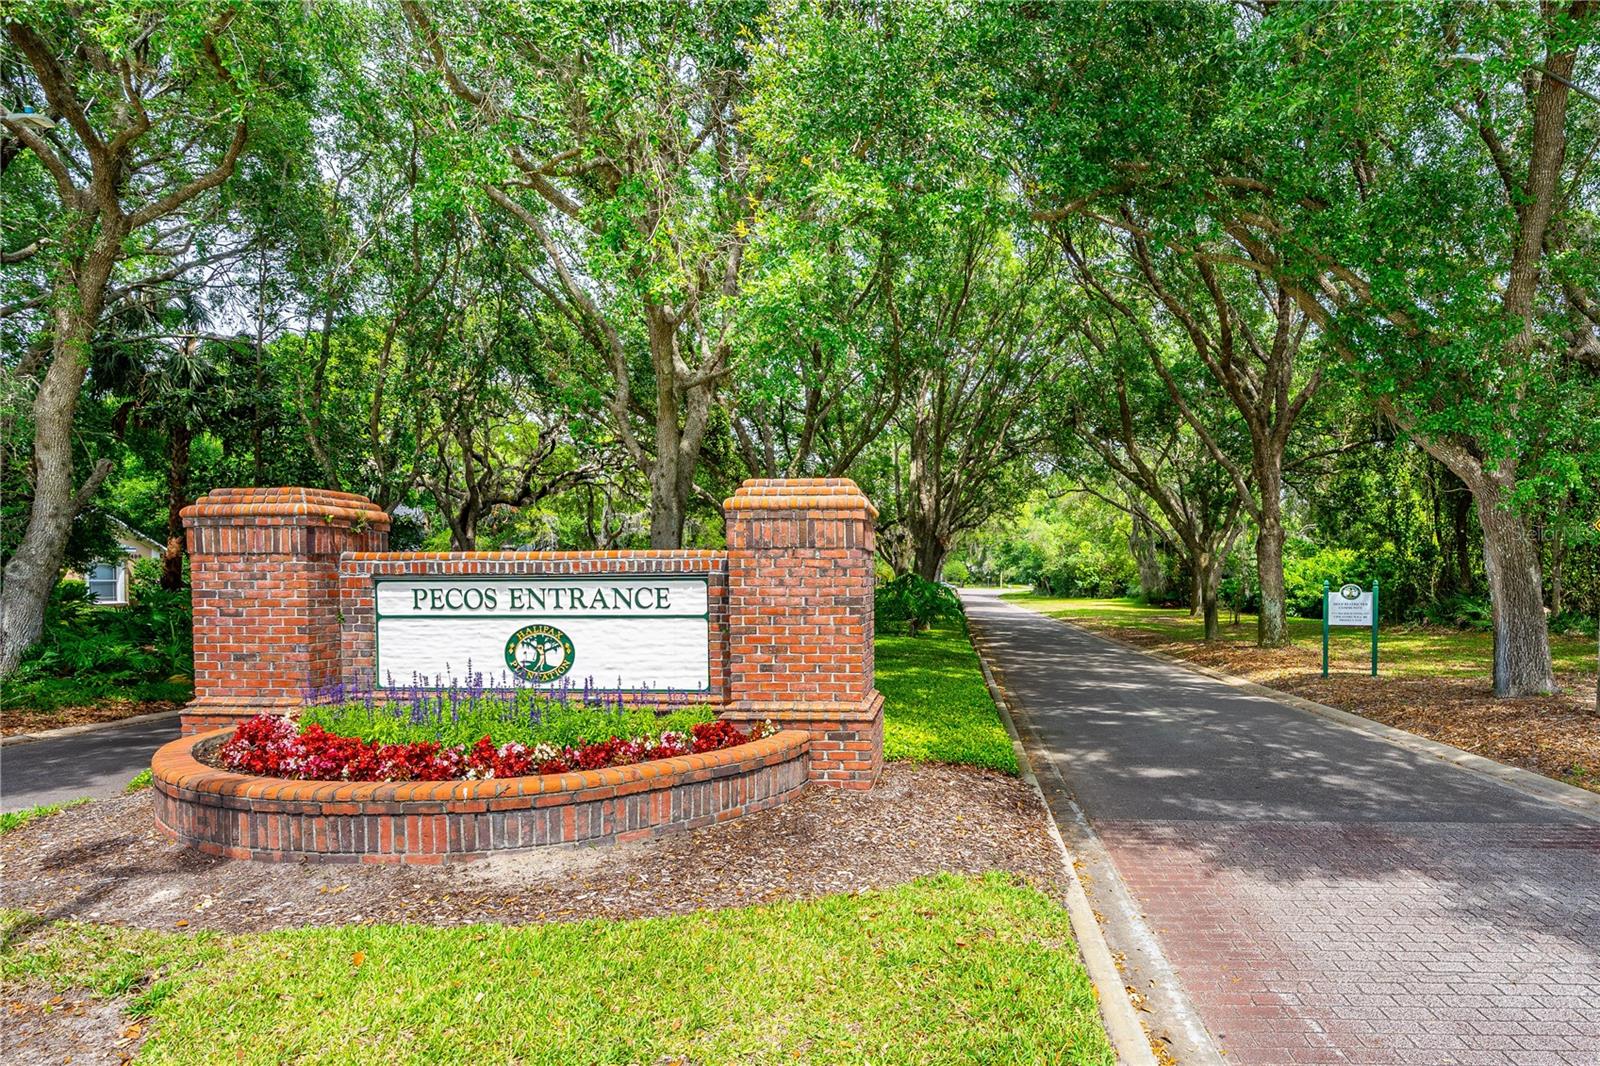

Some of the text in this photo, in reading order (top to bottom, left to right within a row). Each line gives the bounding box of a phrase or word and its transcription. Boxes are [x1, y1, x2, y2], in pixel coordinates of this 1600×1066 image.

[412, 587, 671, 611] PECOS ENTRANCE
[516, 626, 564, 640] HALIFAX
[510, 659, 571, 680] PLNATION
